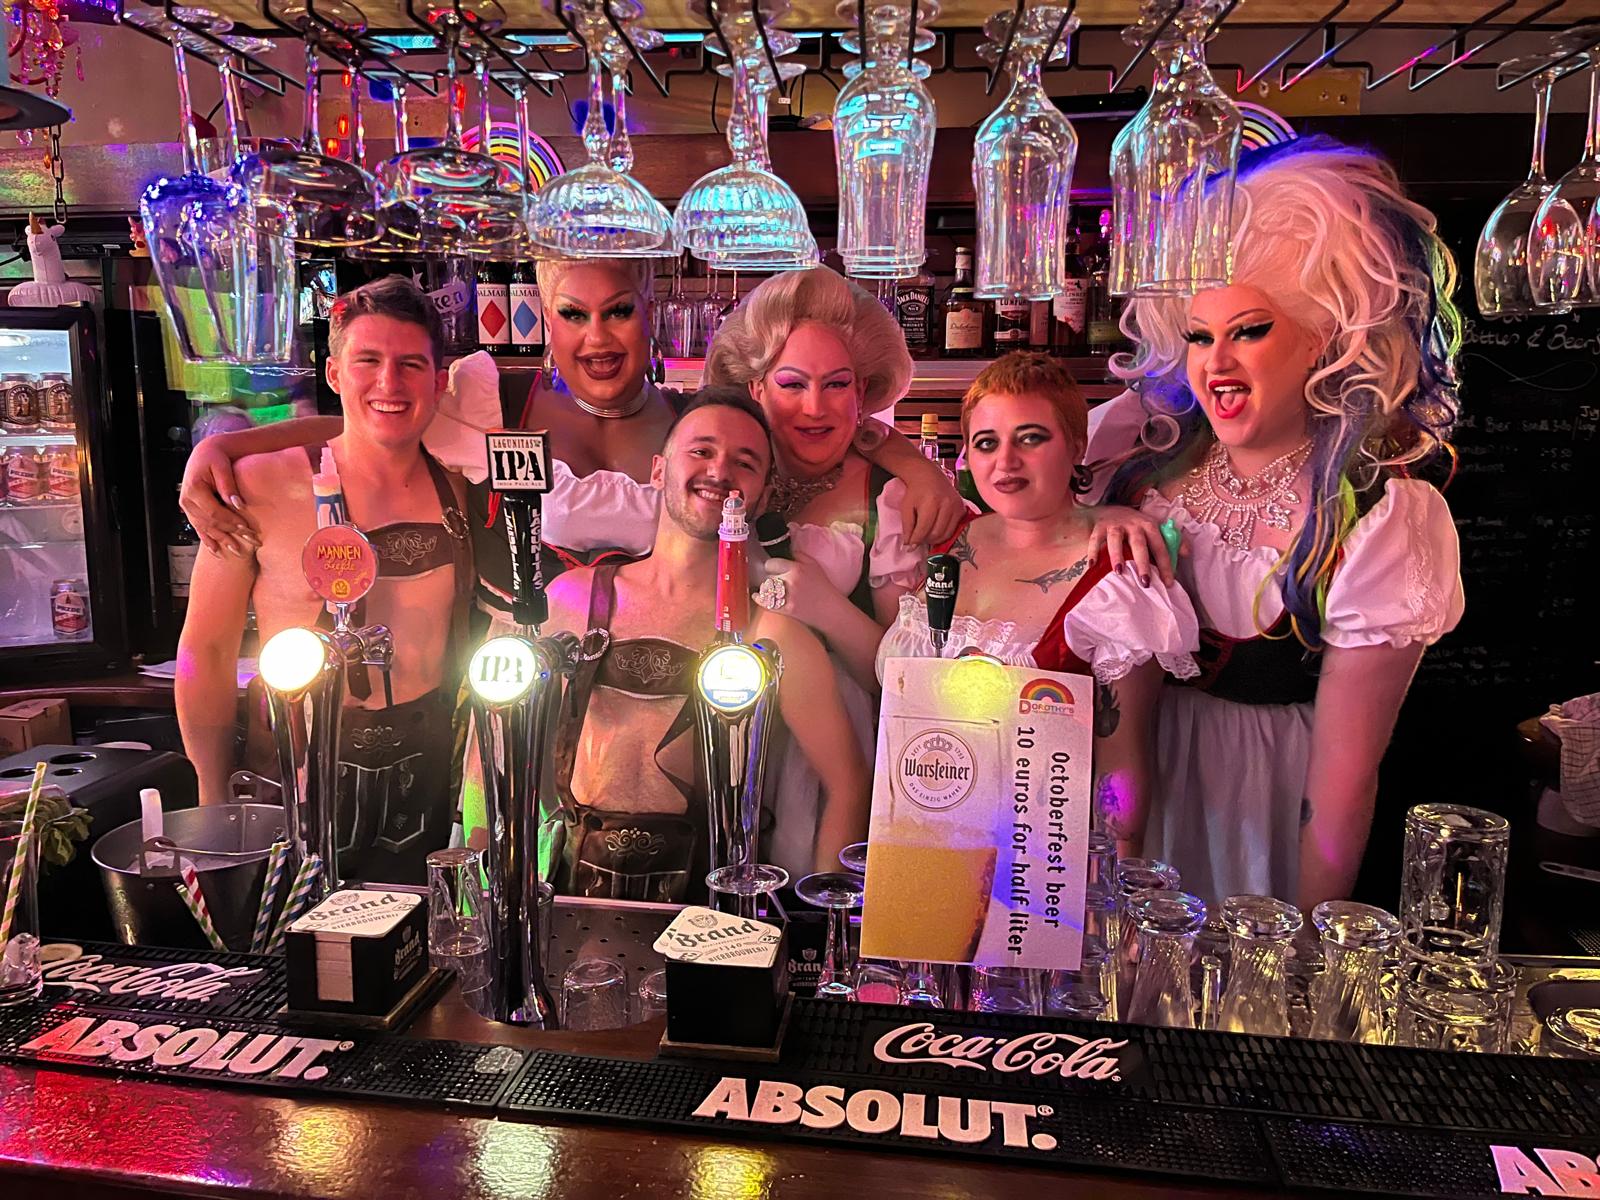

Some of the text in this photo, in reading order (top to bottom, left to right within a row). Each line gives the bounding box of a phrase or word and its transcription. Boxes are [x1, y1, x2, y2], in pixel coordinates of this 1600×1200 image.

[492, 438, 535, 449] LAGUNITAS
[492, 450, 545, 481] IPA
[316, 544, 362, 561] MANNEN
[503, 507, 522, 591] LAGUNITAS
[530, 508, 544, 590] LAGUNITAS
[926, 575, 955, 589] Brand
[479, 655, 524, 683] IPA
[904, 757, 971, 781] Warsteiner
[909, 782, 920, 794] DAS
[1007, 726, 1036, 956] 10 euros for half liter
[1044, 751, 1071, 928] Octoberfest beer
[307, 893, 400, 922] Brand
[675, 920, 760, 949] Brand
[787, 958, 822, 974] Bran
[873, 1022, 1129, 1082] Coca-Cola
[1489, 1144, 1600, 1200] AB
